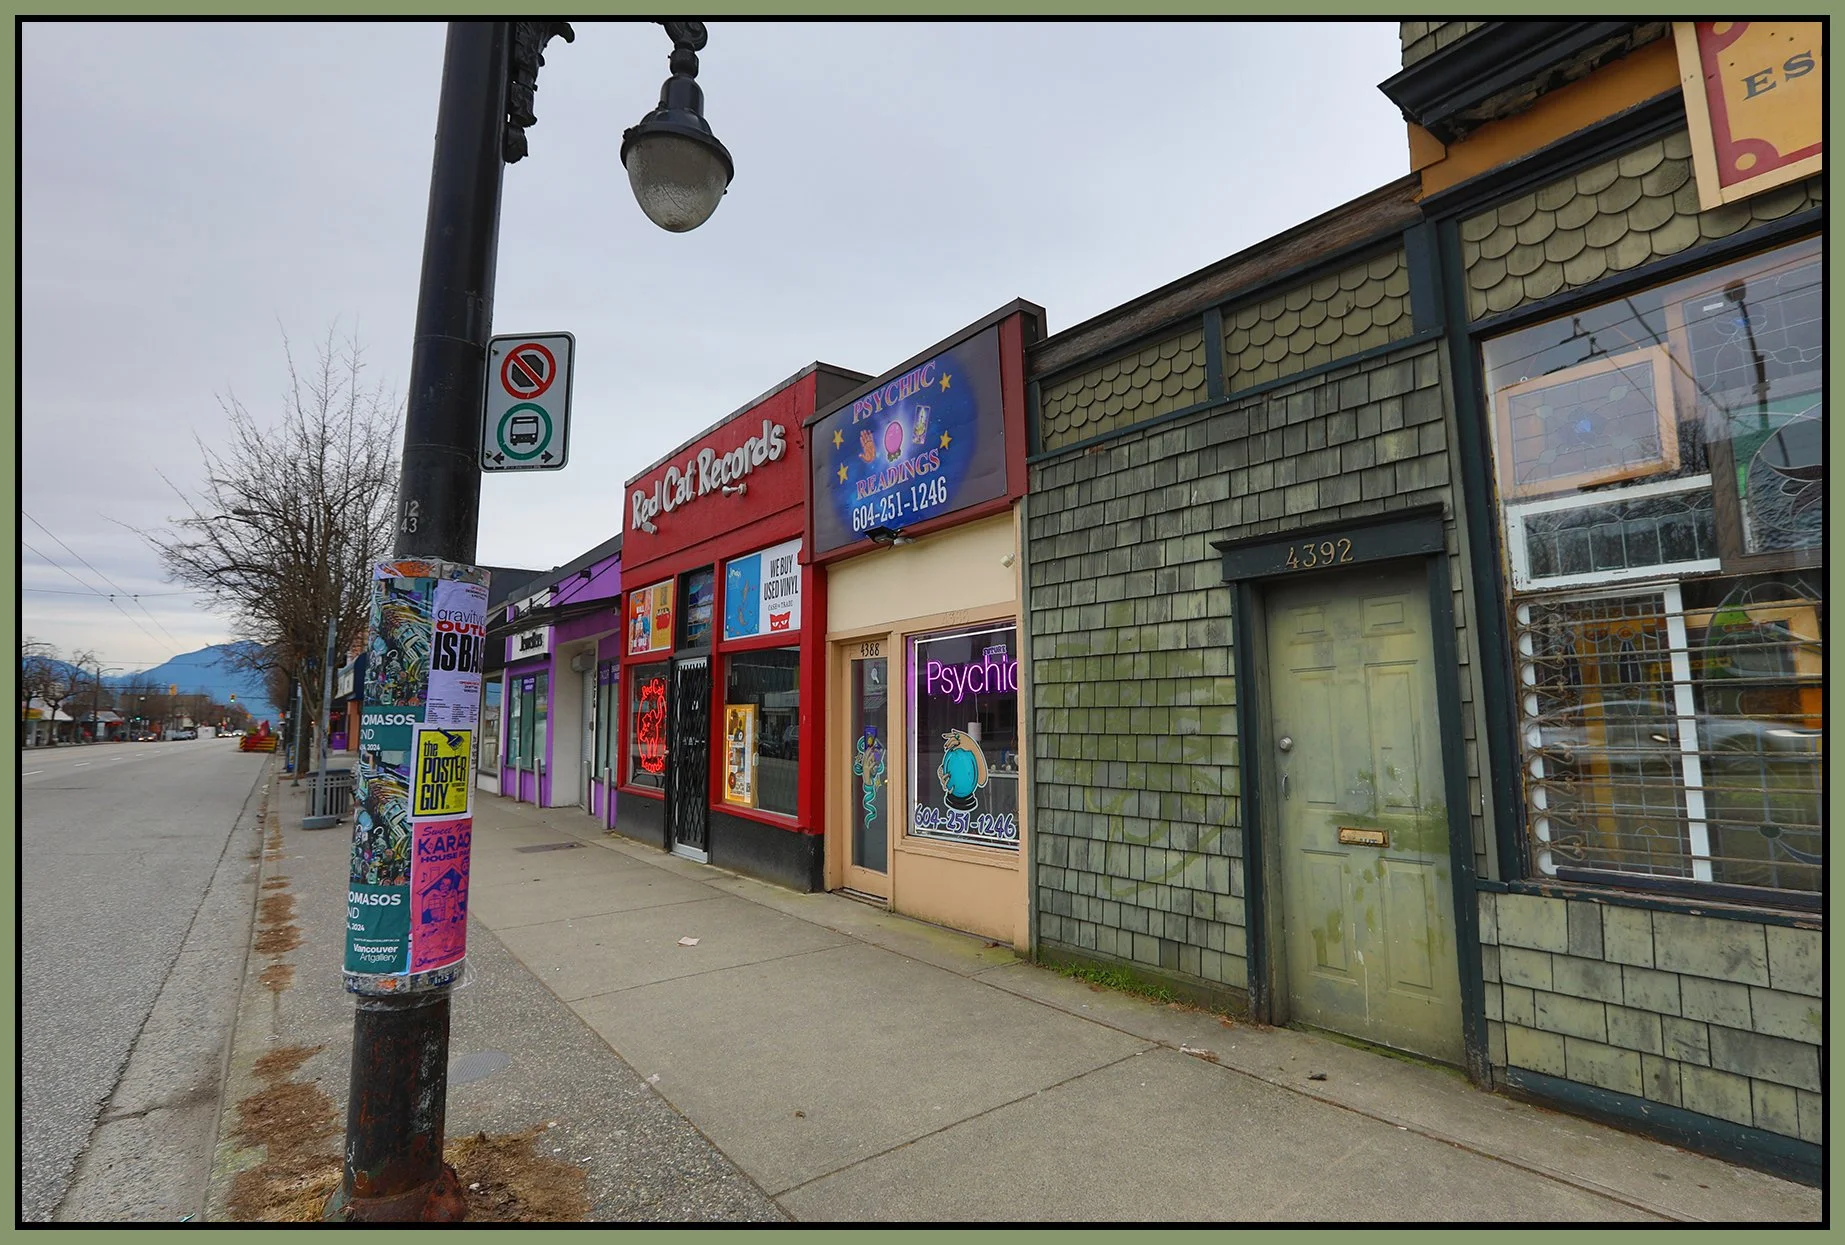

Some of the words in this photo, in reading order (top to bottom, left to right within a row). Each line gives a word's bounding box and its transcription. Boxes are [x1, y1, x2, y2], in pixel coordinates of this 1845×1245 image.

[852, 361, 936, 425] PSYCHIC
[632, 480, 662, 530] Red
[663, 460, 696, 513] Cat
[697, 419, 787, 497] Records
[856, 448, 942, 500] READINGS
[852, 476, 948, 532] 604-251-1246
[401, 517, 417, 533] 43
[770, 558, 779, 578] WE
[780, 554, 794, 575] BUY
[1285, 538, 1354, 569] 4392
[763, 579, 779, 601] USED
[780, 575, 798, 597] VINYL
[860, 642, 880, 657] 4388
[423, 740, 438, 757] the
[422, 755, 467, 784] POSTER
[914, 803, 1017, 840] 604-251-1246
[420, 851, 458, 864] HOUSE
[353, 943, 399, 954] Vancouver
[359, 953, 398, 963] Artgallery
